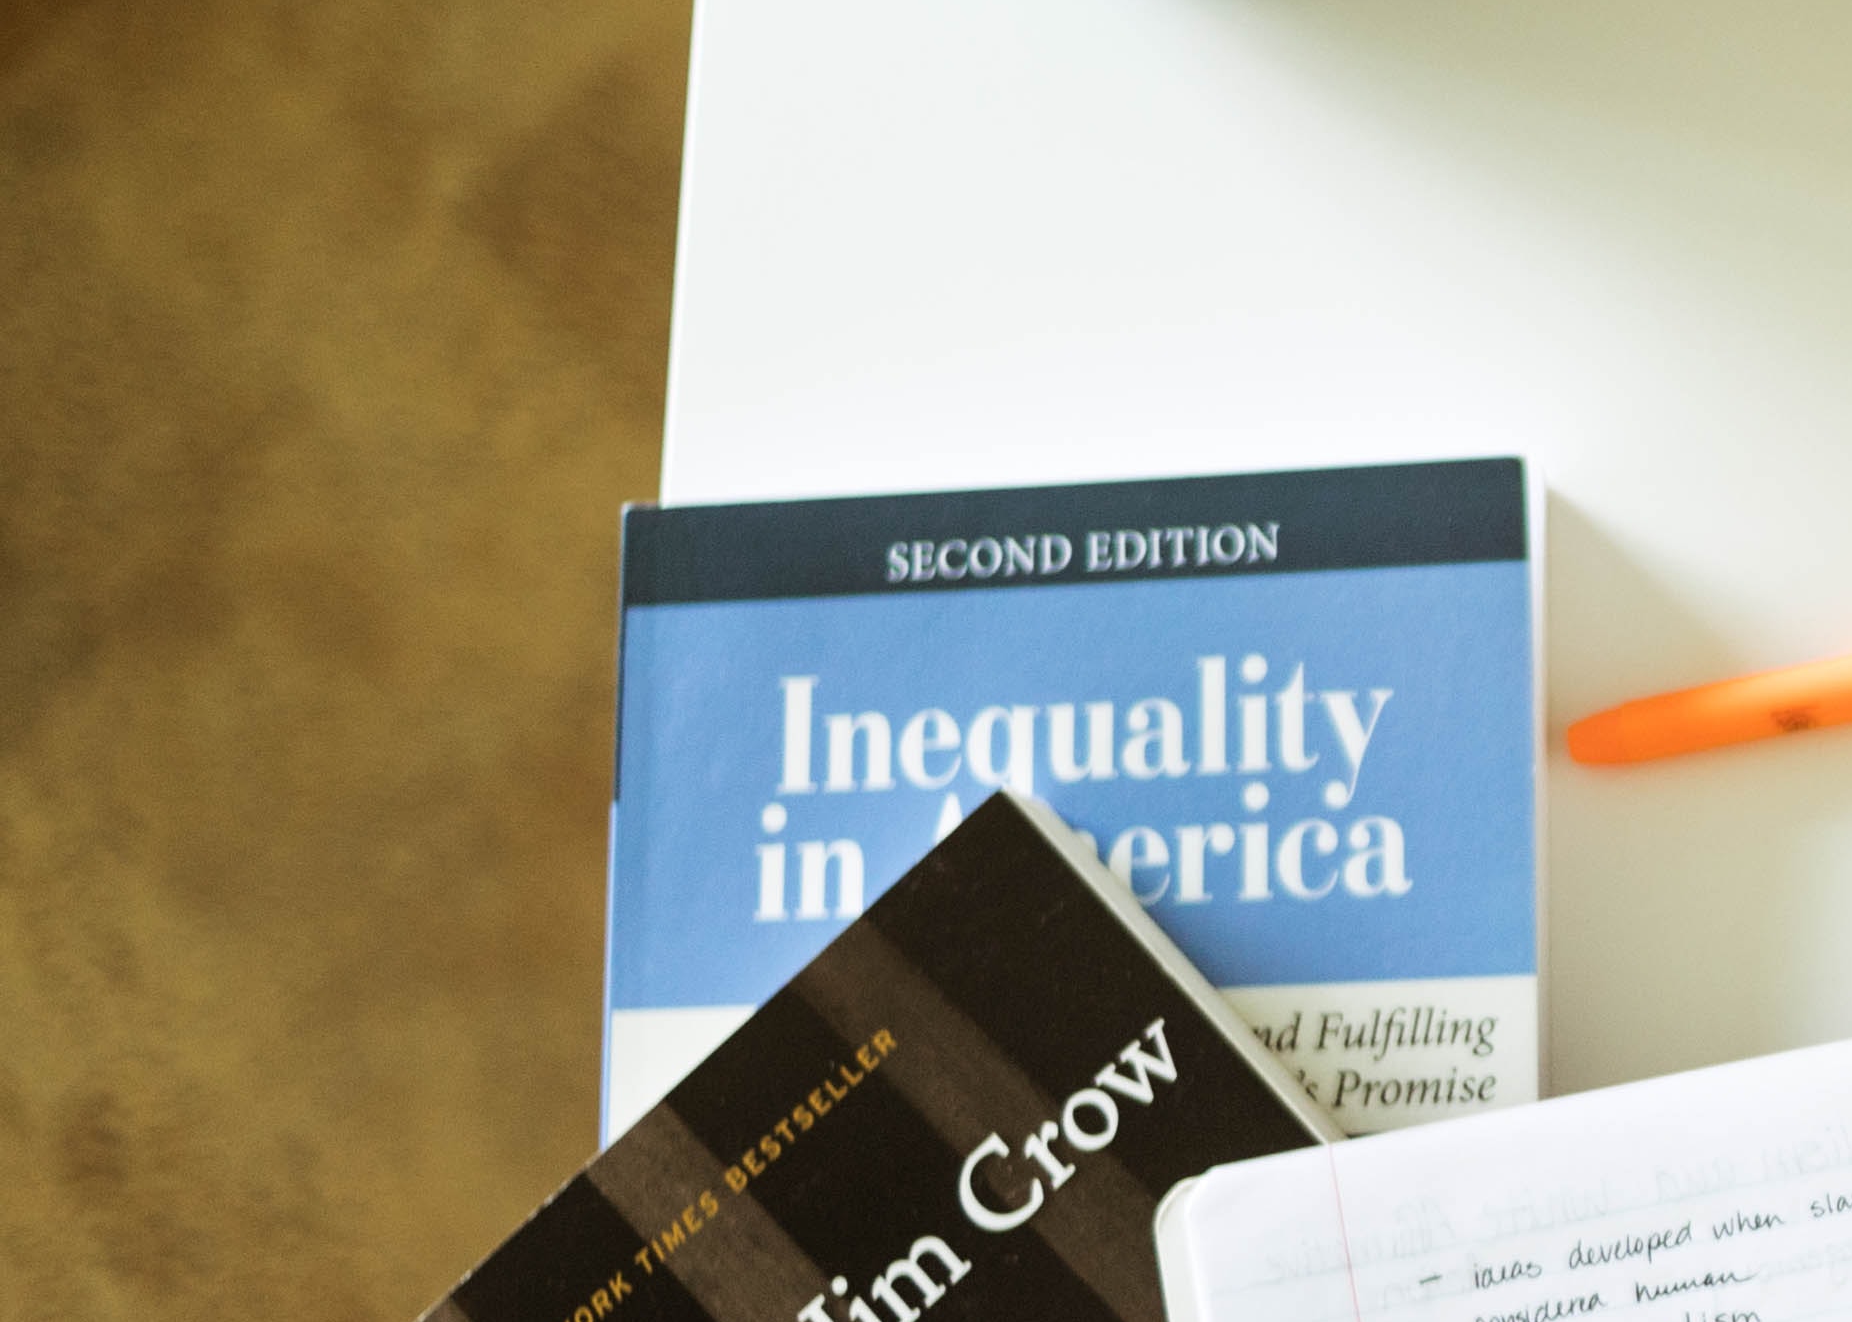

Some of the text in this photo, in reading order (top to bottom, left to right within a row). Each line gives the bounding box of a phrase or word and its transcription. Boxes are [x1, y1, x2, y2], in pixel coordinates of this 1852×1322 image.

[885, 522, 1282, 584] SECOND EDITION
[774, 653, 1396, 804] Inequality
[753, 803, 868, 923] in
[1315, 1006, 1498, 1062] Fulfilling
[1330, 1072, 1493, 1108] Promise
[633, 1190, 721, 1277] TIMES
[723, 1026, 901, 1196] BESTSELLER
[957, 1016, 1183, 1234] Crow
